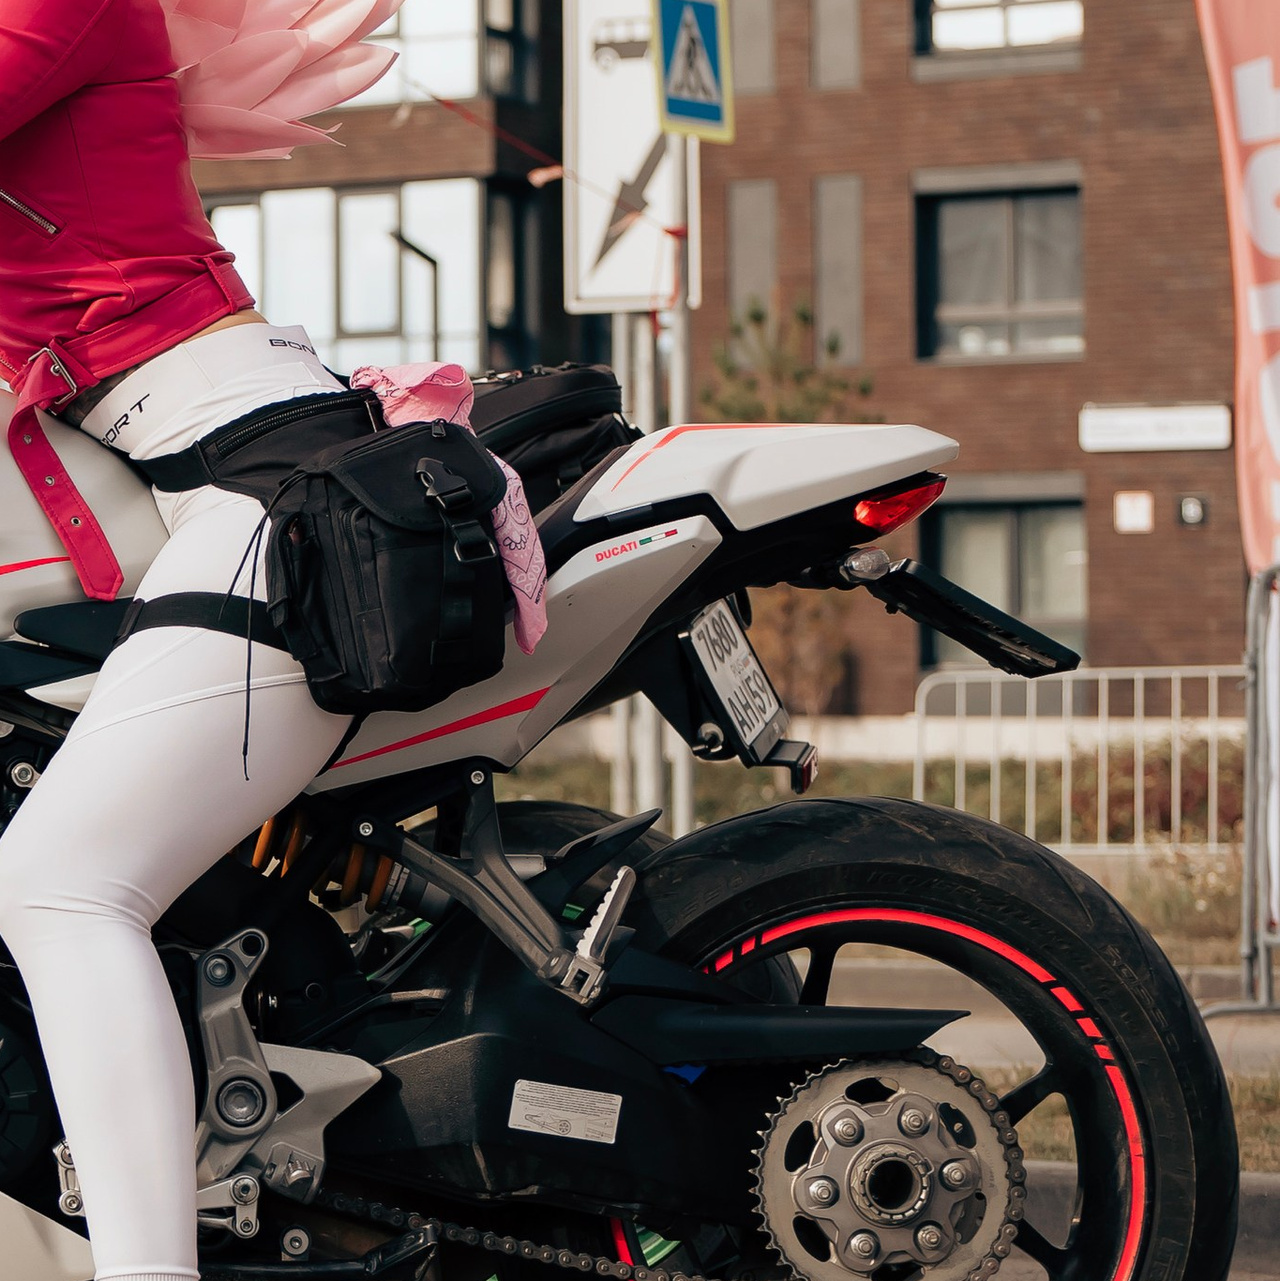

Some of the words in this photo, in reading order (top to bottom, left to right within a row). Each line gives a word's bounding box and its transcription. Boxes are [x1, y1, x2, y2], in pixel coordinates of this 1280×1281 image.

[595, 540, 638, 562] DUCATI
[696, 610, 739, 673] 7680
[744, 669, 773, 716] 59
